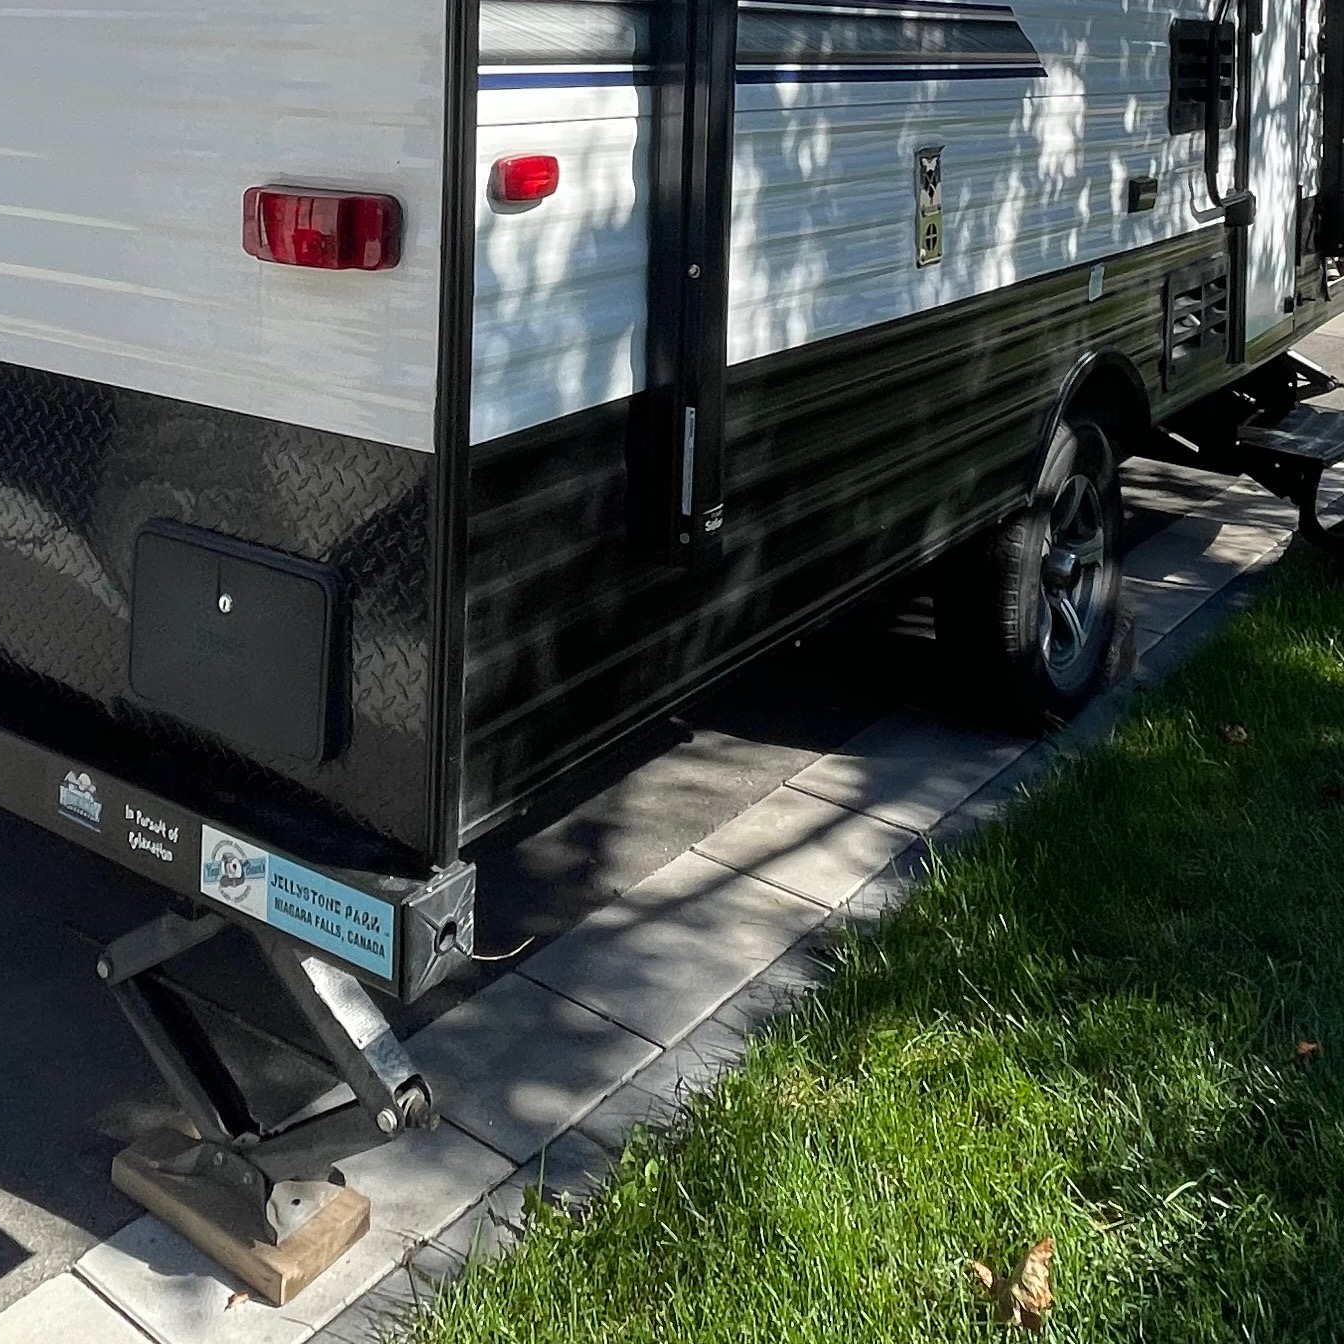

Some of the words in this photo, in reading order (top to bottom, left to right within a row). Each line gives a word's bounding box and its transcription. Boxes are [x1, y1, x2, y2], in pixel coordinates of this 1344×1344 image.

[168, 827, 179, 843] of
[270, 873, 341, 916] JELLYSTONE
[274, 896, 312, 926] NIAGARA
[314, 915, 344, 943] FALLS,
[347, 930, 386, 958] CANADA
